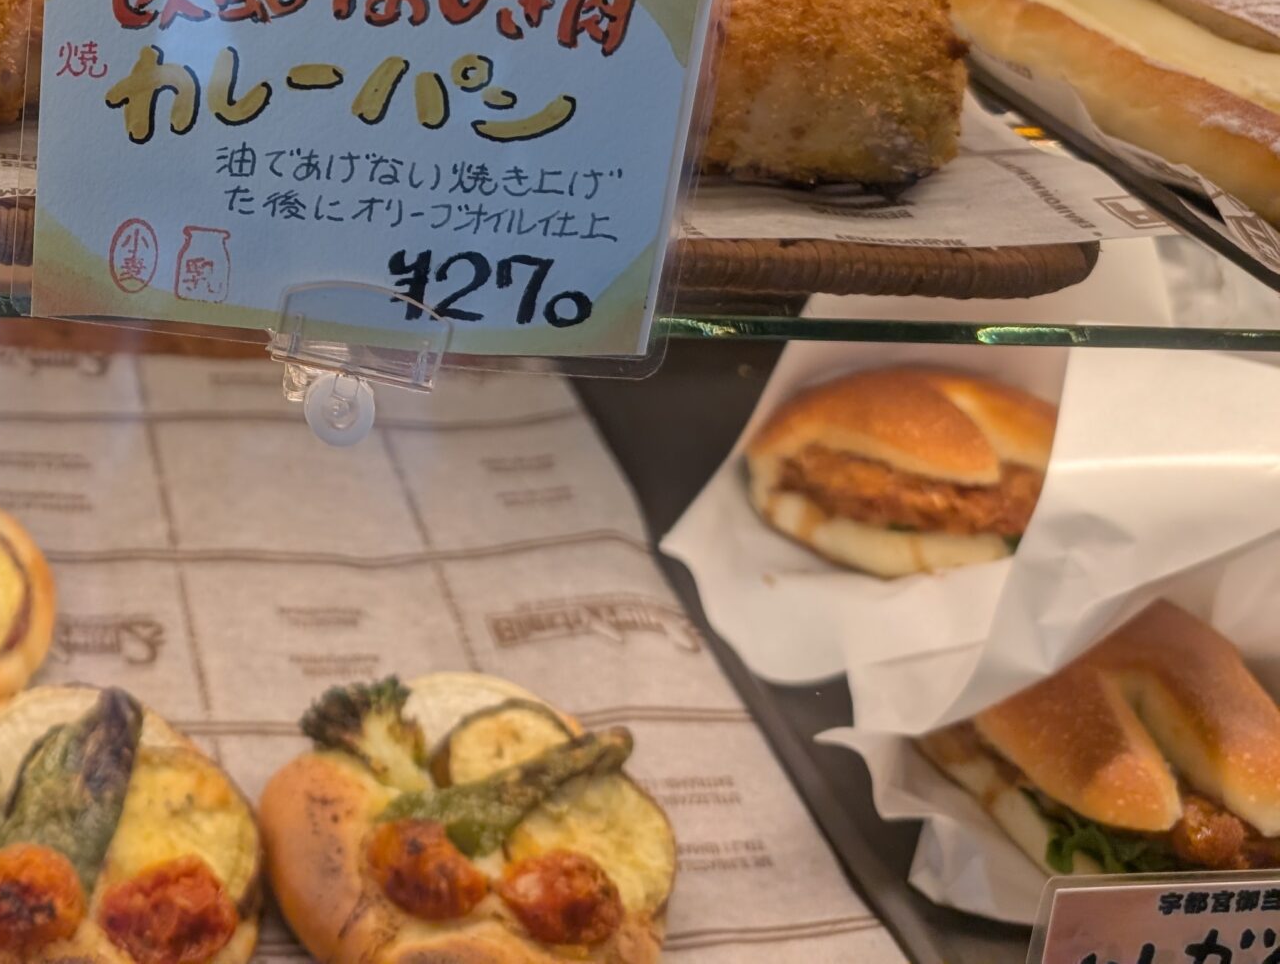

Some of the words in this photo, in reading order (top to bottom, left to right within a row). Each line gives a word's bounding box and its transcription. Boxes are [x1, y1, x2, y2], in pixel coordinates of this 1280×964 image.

[55, 41, 109, 79] 焼
[105, 44, 577, 145] カレーパン
[216, 141, 623, 200] 油であげない焼き上げ
[224, 185, 618, 242] た後にオリーブオイル仕上
[388, 248, 593, 328] ¥270
